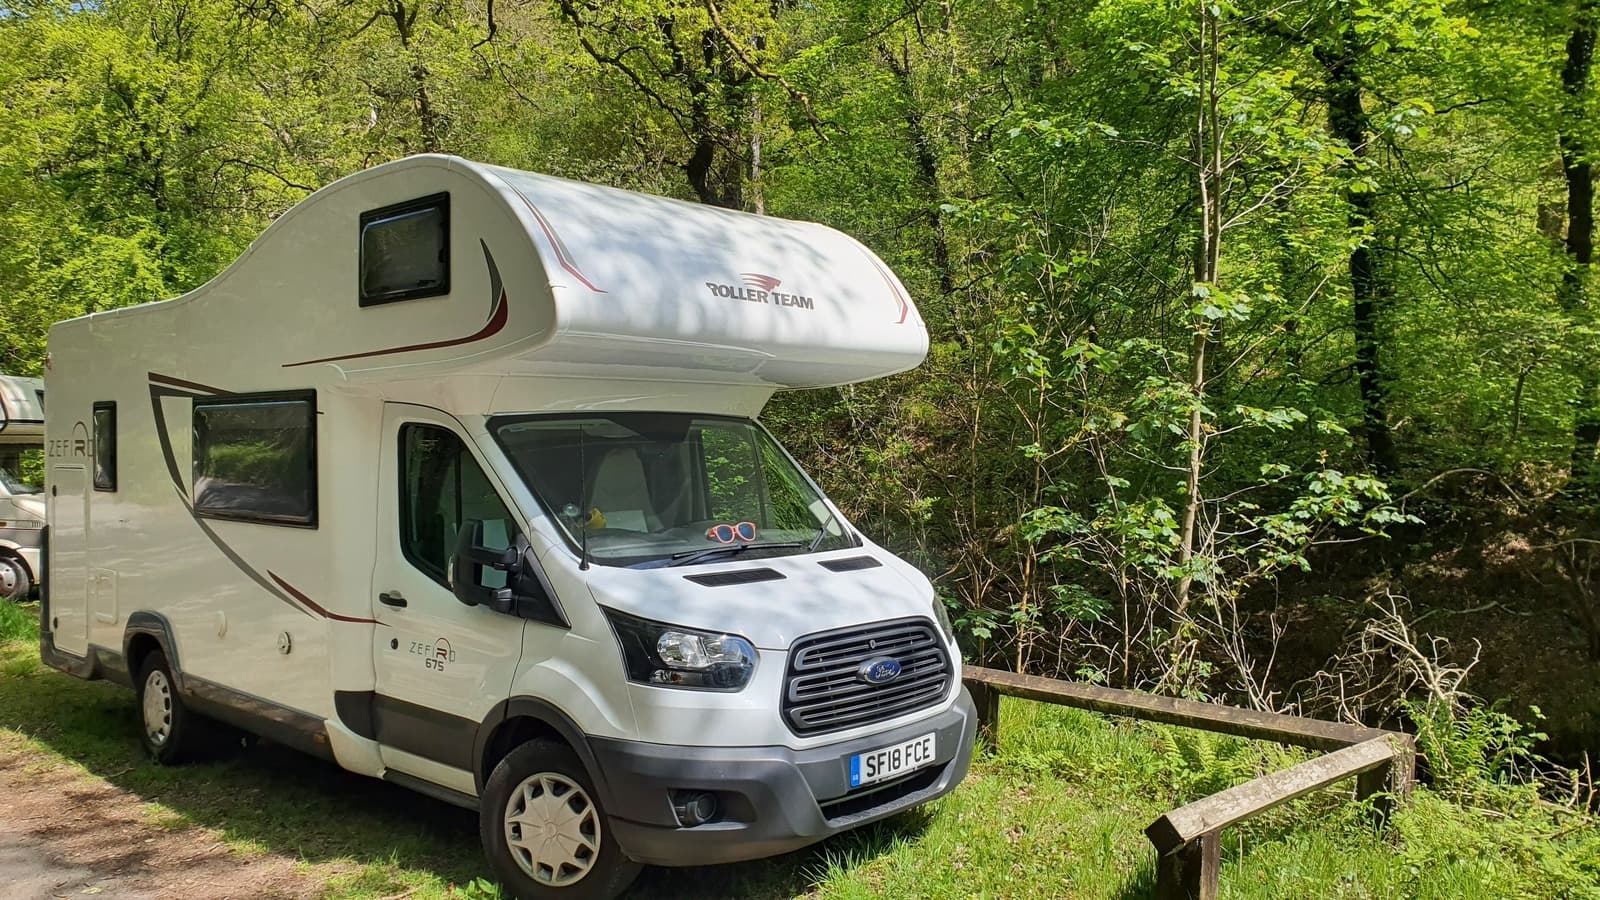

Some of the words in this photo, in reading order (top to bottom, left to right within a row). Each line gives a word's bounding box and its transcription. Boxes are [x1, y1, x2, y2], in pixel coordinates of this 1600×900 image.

[705, 282, 769, 304] ROLLER
[772, 292, 814, 310] TEAM
[425, 658, 444, 672] 675
[875, 661, 896, 679] Ford
[866, 748, 901, 778] SF18
[905, 738, 931, 767] FCE
